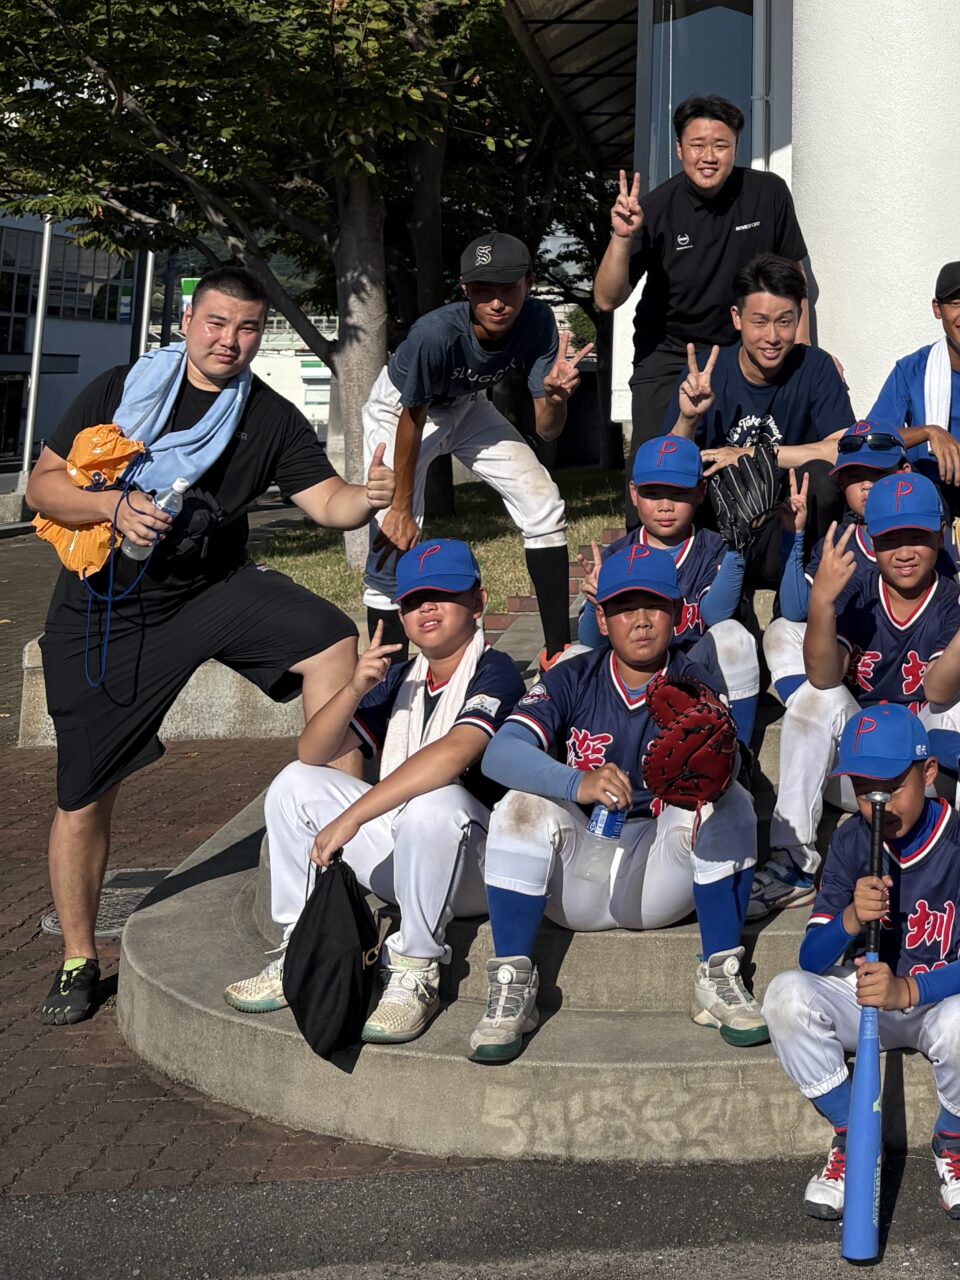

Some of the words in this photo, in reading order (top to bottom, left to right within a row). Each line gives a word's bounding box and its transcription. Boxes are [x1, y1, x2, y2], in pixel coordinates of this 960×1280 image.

[475, 245, 492, 266] S
[657, 440, 678, 467] P
[895, 481, 913, 513] P
[416, 545, 441, 573] P
[625, 545, 650, 575] P
[853, 717, 877, 753] P
